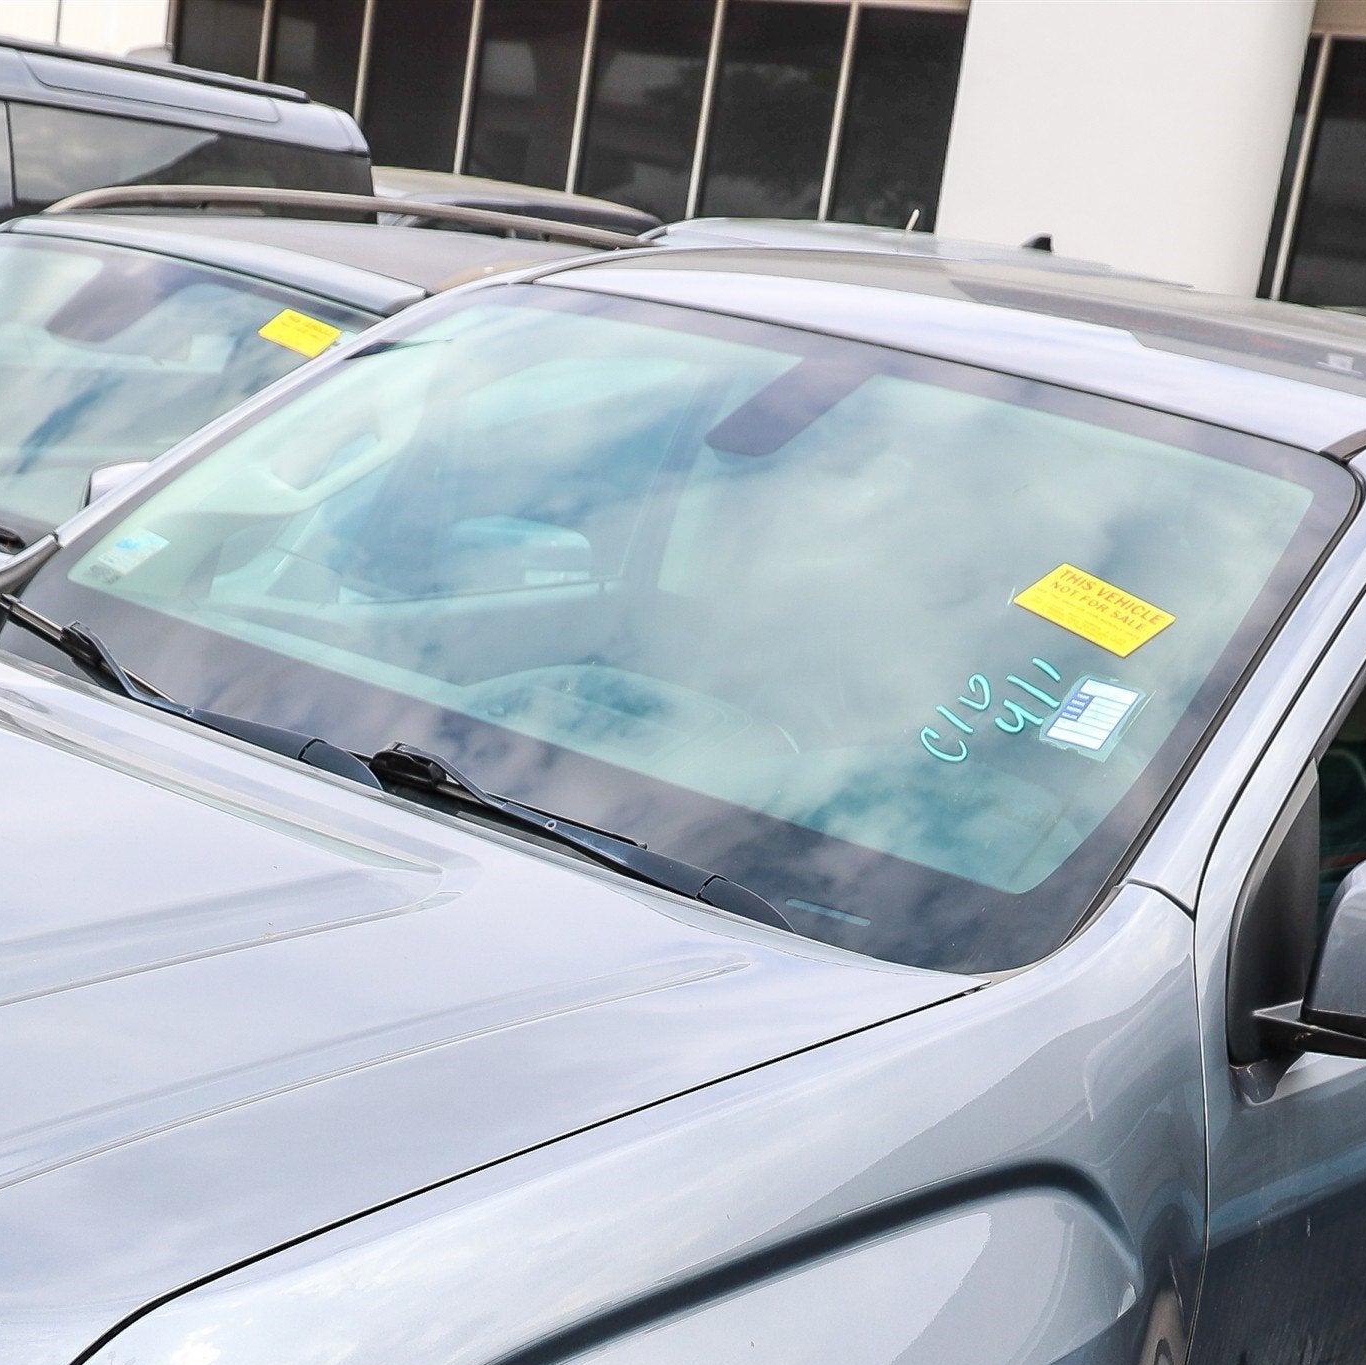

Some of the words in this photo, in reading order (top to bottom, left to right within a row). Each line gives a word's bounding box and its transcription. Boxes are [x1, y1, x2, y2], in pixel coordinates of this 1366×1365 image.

[1051, 580, 1081, 598] NOT
[1080, 595, 1110, 613] FOR
[1110, 608, 1145, 631] SALE
[1060, 569, 1097, 591] THIS
[1097, 587, 1165, 625] VEHICLE
